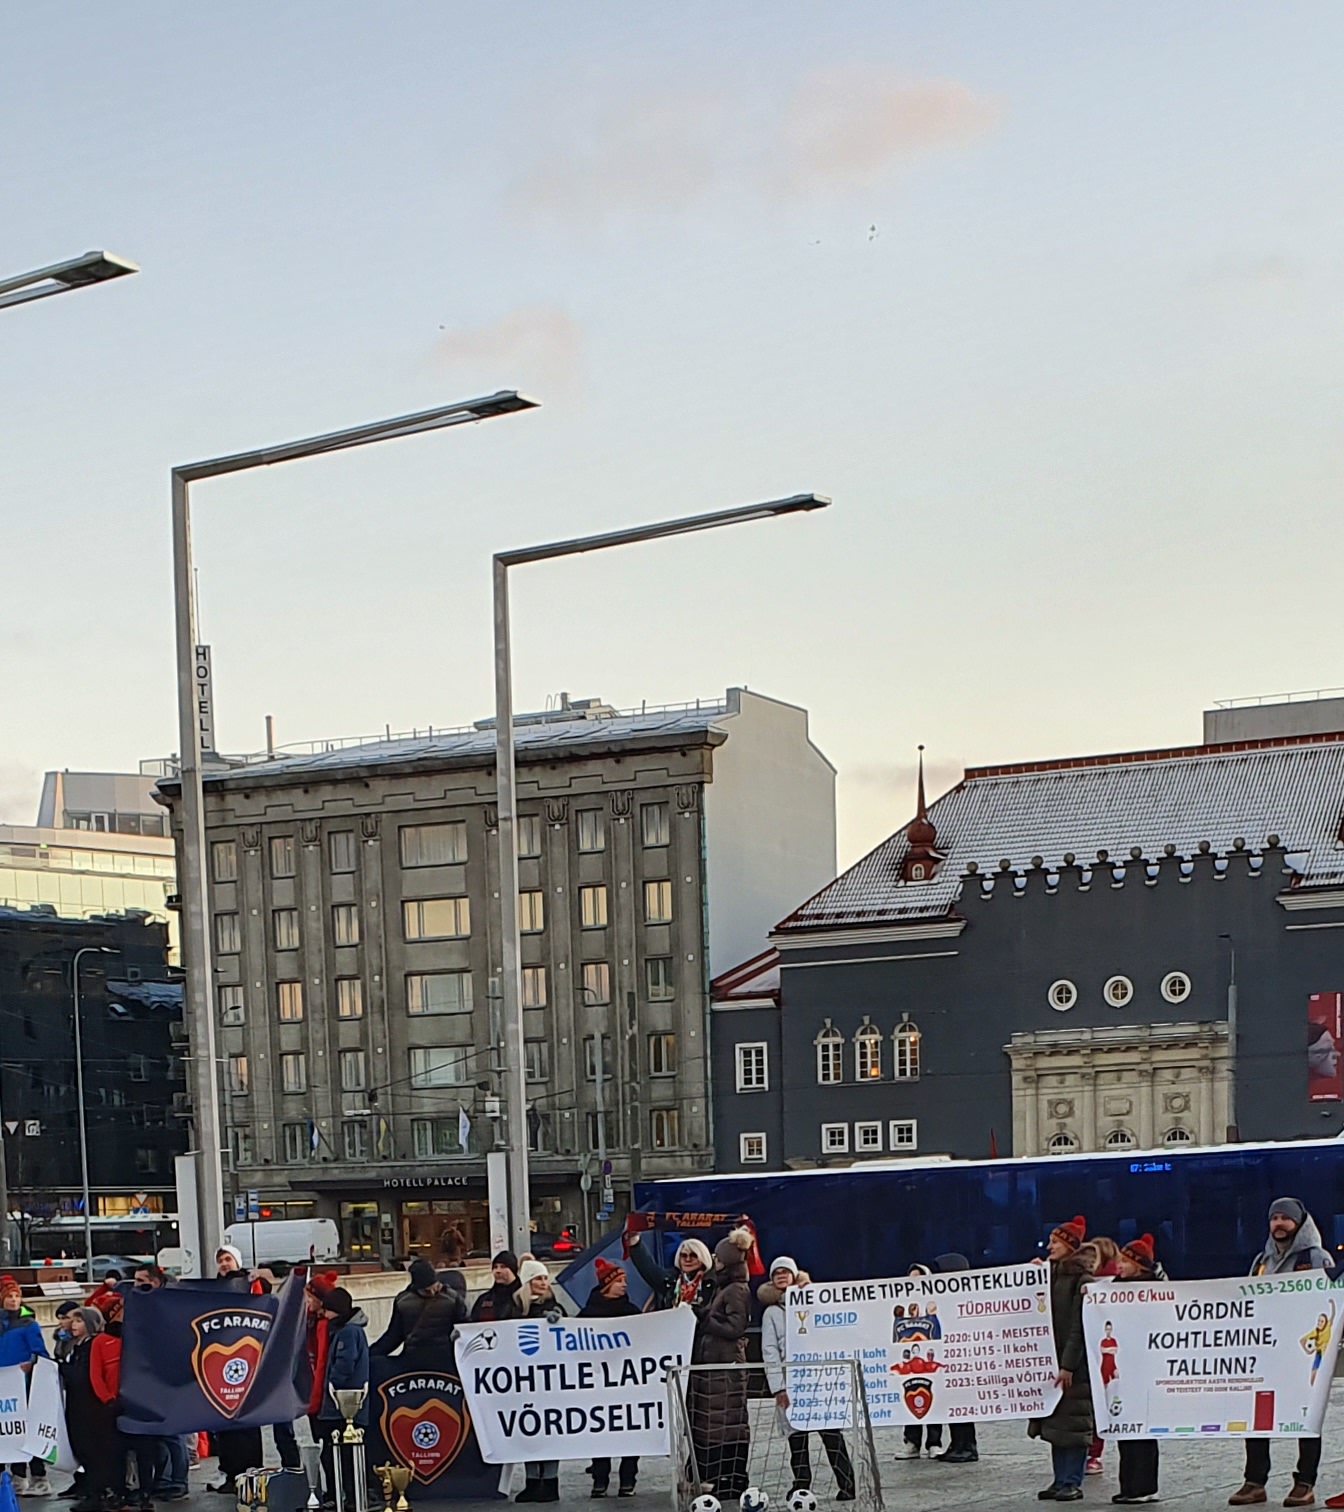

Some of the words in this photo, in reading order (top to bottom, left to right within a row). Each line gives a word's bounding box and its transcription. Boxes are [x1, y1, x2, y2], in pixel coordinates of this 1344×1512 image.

[196, 647, 210, 749] HOTELL
[383, 1179, 424, 1187] HOTELL
[426, 1177, 468, 1186] PALACE
[789, 1290, 814, 1306] ME
[819, 1285, 876, 1304] OLEME
[879, 1269, 1049, 1298] TIPP-NOORTEKLUBI!
[1111, 1291, 1134, 1303] 000
[1138, 1289, 1175, 1302] €/kuu
[1239, 1278, 1312, 1297] 1153-2560
[957, 1298, 1032, 1316] TÜDRUKUD
[1175, 1299, 1254, 1321] VÕRDNE
[202, 1319, 221, 1333] FC
[814, 1312, 857, 1326] POISID
[549, 1327, 632, 1352] Tallinn
[944, 1334, 971, 1344] 2020:
[973, 1331, 993, 1341] U14
[1002, 1326, 1050, 1339] MEISTER
[1148, 1328, 1277, 1350] KOHTLEMINE,
[863, 1348, 887, 1359] koht
[944, 1348, 971, 1358] 2021:
[973, 1346, 994, 1356] U15
[1013, 1342, 1038, 1353] koht
[864, 1364, 887, 1374] koht
[944, 1363, 972, 1373] 2022:
[975, 1362, 996, 1371] U16
[1005, 1356, 1052, 1369] MEISTER
[1166, 1357, 1257, 1376] TALLINN?
[474, 1362, 594, 1394] KOHTLE
[945, 1378, 974, 1388] 2023:
[388, 1383, 406, 1397] FC
[409, 1379, 461, 1395] ARARAT
[978, 1390, 999, 1400] U15
[1017, 1387, 1042, 1397] koht
[866, 1392, 901, 1404] EISTER
[949, 1407, 978, 1417] 2024:
[980, 1405, 1001, 1414] U16
[1020, 1402, 1044, 1412] koht
[497, 1401, 664, 1437] VÕRDSELT!
